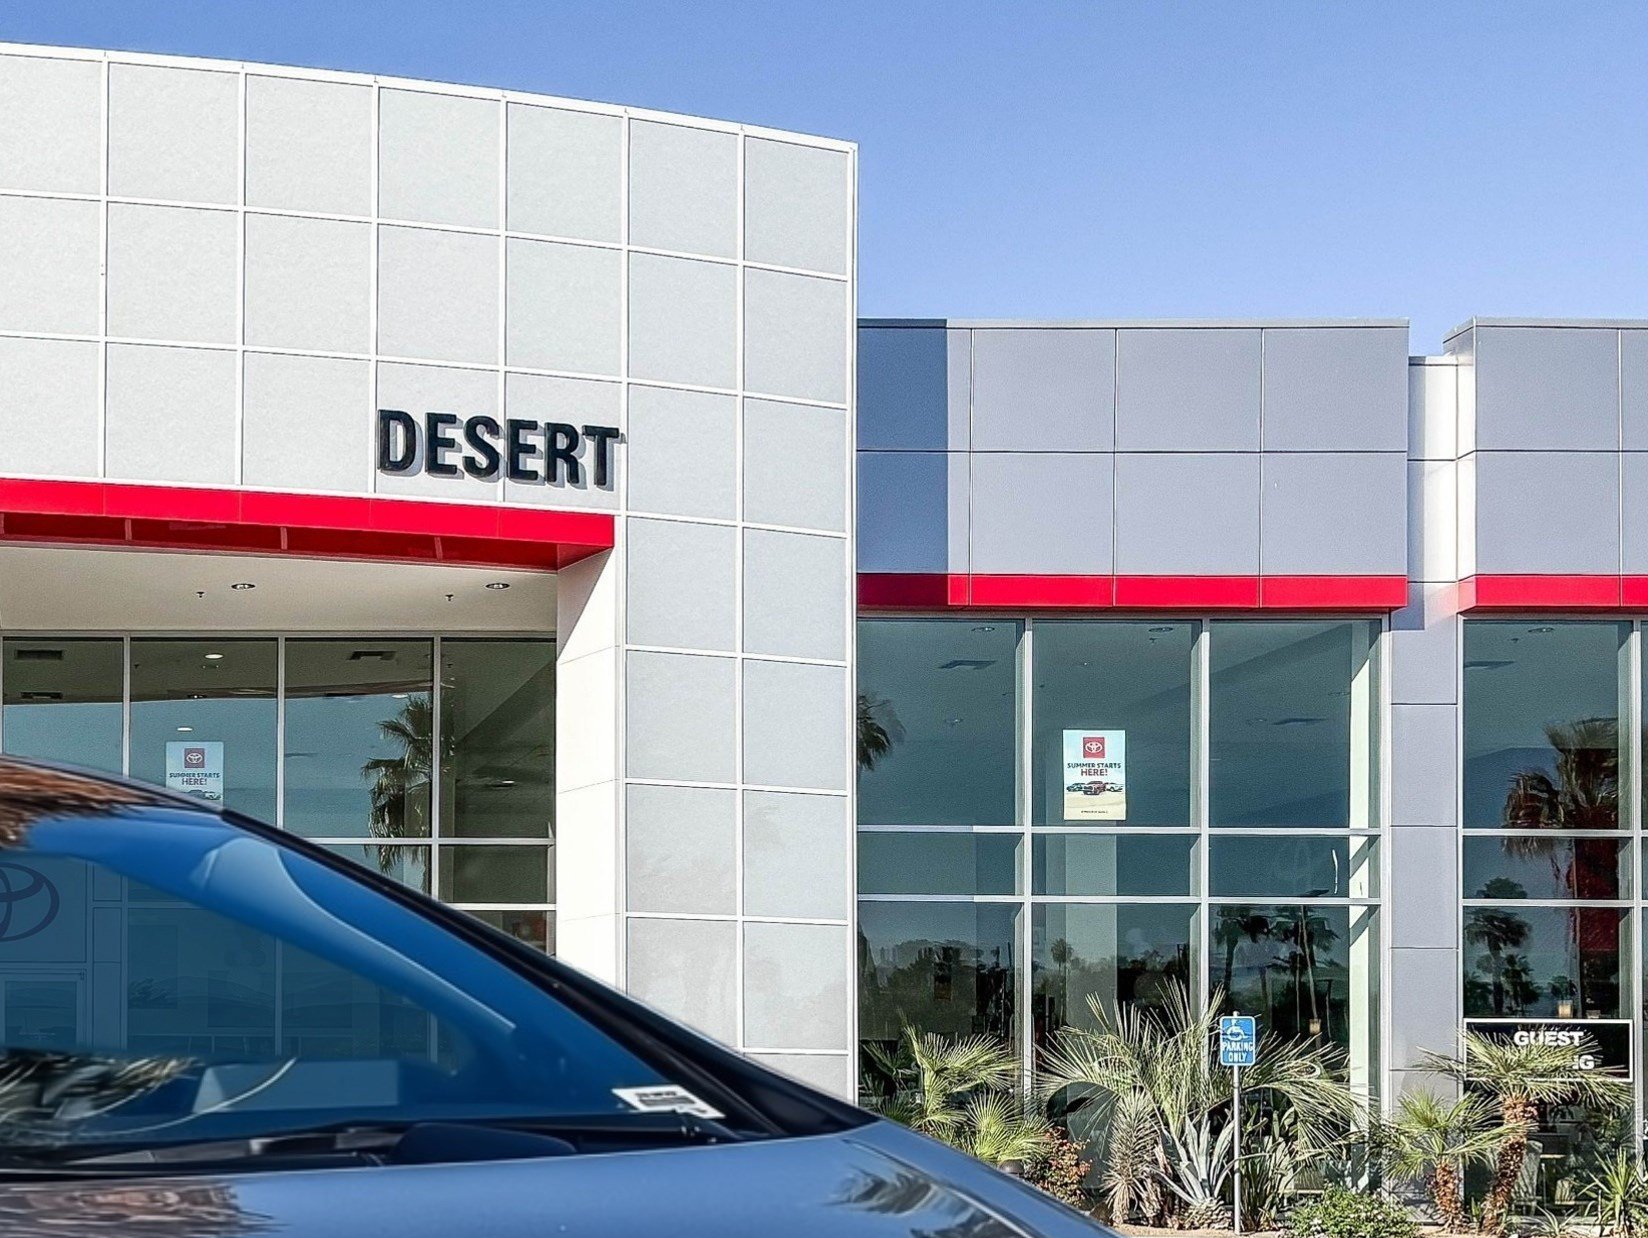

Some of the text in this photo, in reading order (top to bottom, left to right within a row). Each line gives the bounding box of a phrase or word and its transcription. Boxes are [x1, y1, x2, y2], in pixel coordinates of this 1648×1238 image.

[377, 409, 620, 486] DESERT
[1081, 768, 1108, 776] HERE!
[1513, 1030, 1584, 1047] GUEST
[1222, 1041, 1254, 1052] PARKING
[1228, 1052, 1248, 1062] ONLY
